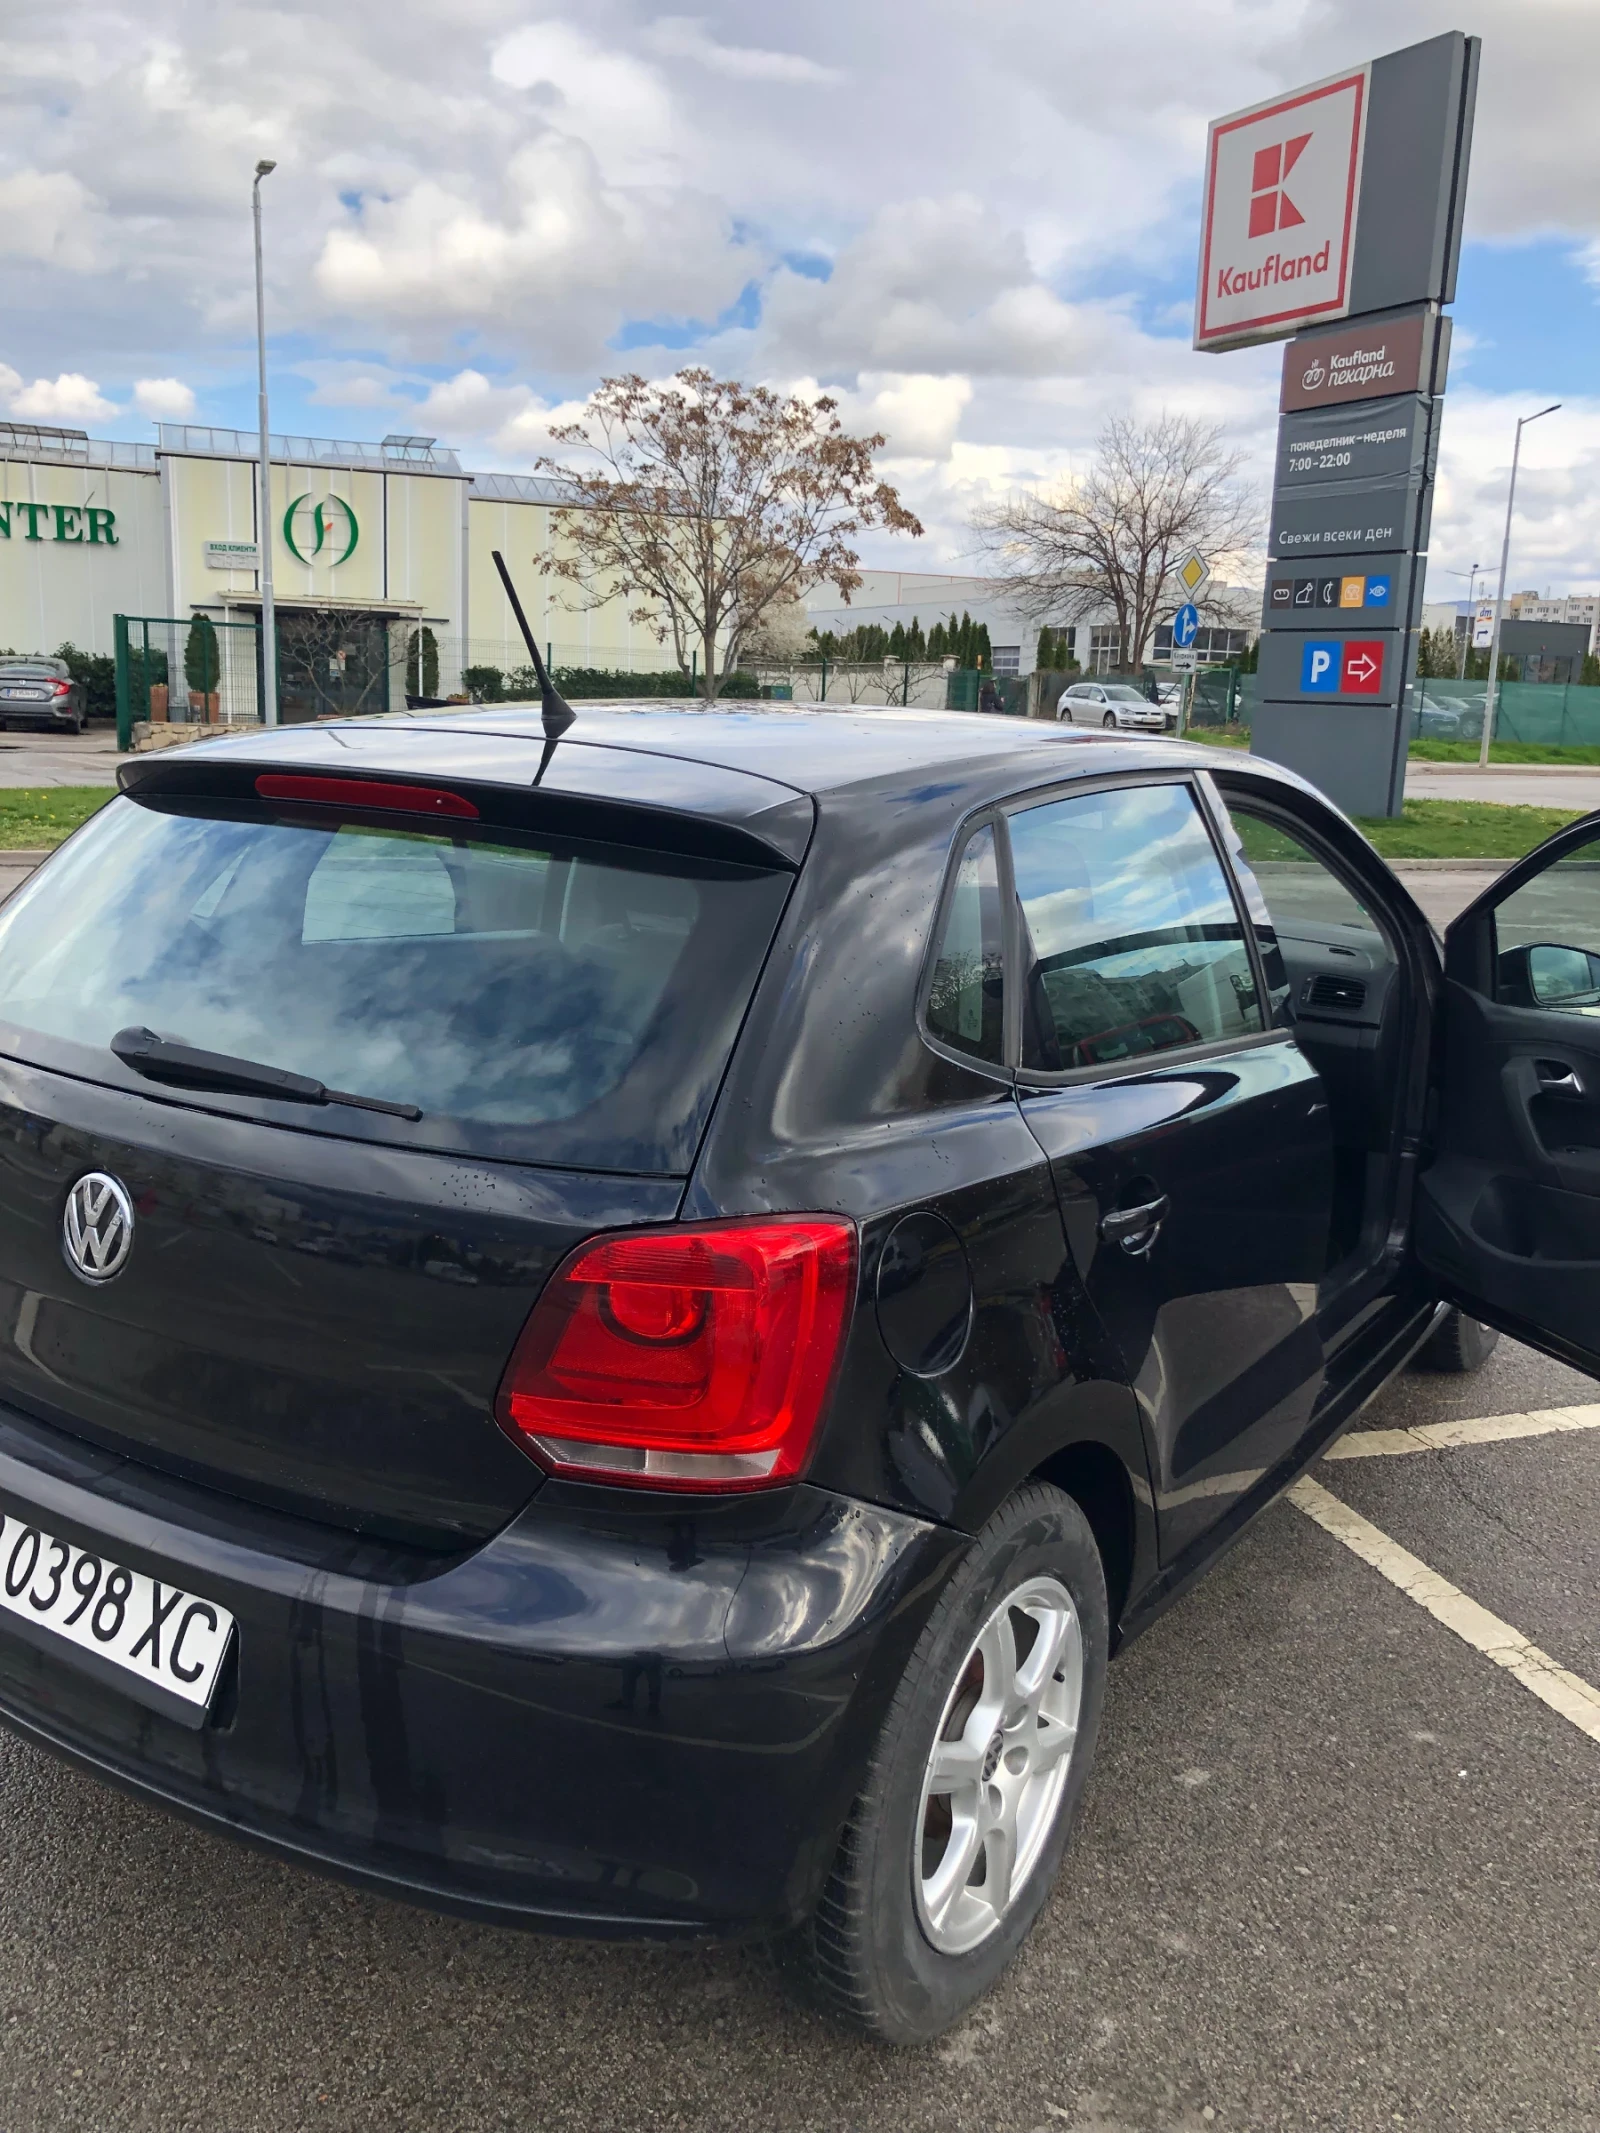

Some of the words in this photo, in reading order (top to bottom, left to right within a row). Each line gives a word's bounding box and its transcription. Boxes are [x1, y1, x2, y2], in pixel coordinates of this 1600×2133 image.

[1217, 240, 1330, 298] Kaufland
[1330, 345, 1386, 370] Kaufland
[1327, 361, 1395, 387] пекарна
[1289, 452, 1351, 473] 7:00-22:00
[209, 543, 228, 552] ВХОД
[228, 544, 257, 553] КЛИЕНТИ
[1279, 531, 1320, 545] Свежи
[1323, 529, 1362, 542] всеки
[1364, 527, 1393, 542] ден
[1480, 607, 1492, 617] dm
[1310, 650, 1330, 683] P
[5, 1526, 133, 1642] 0398
